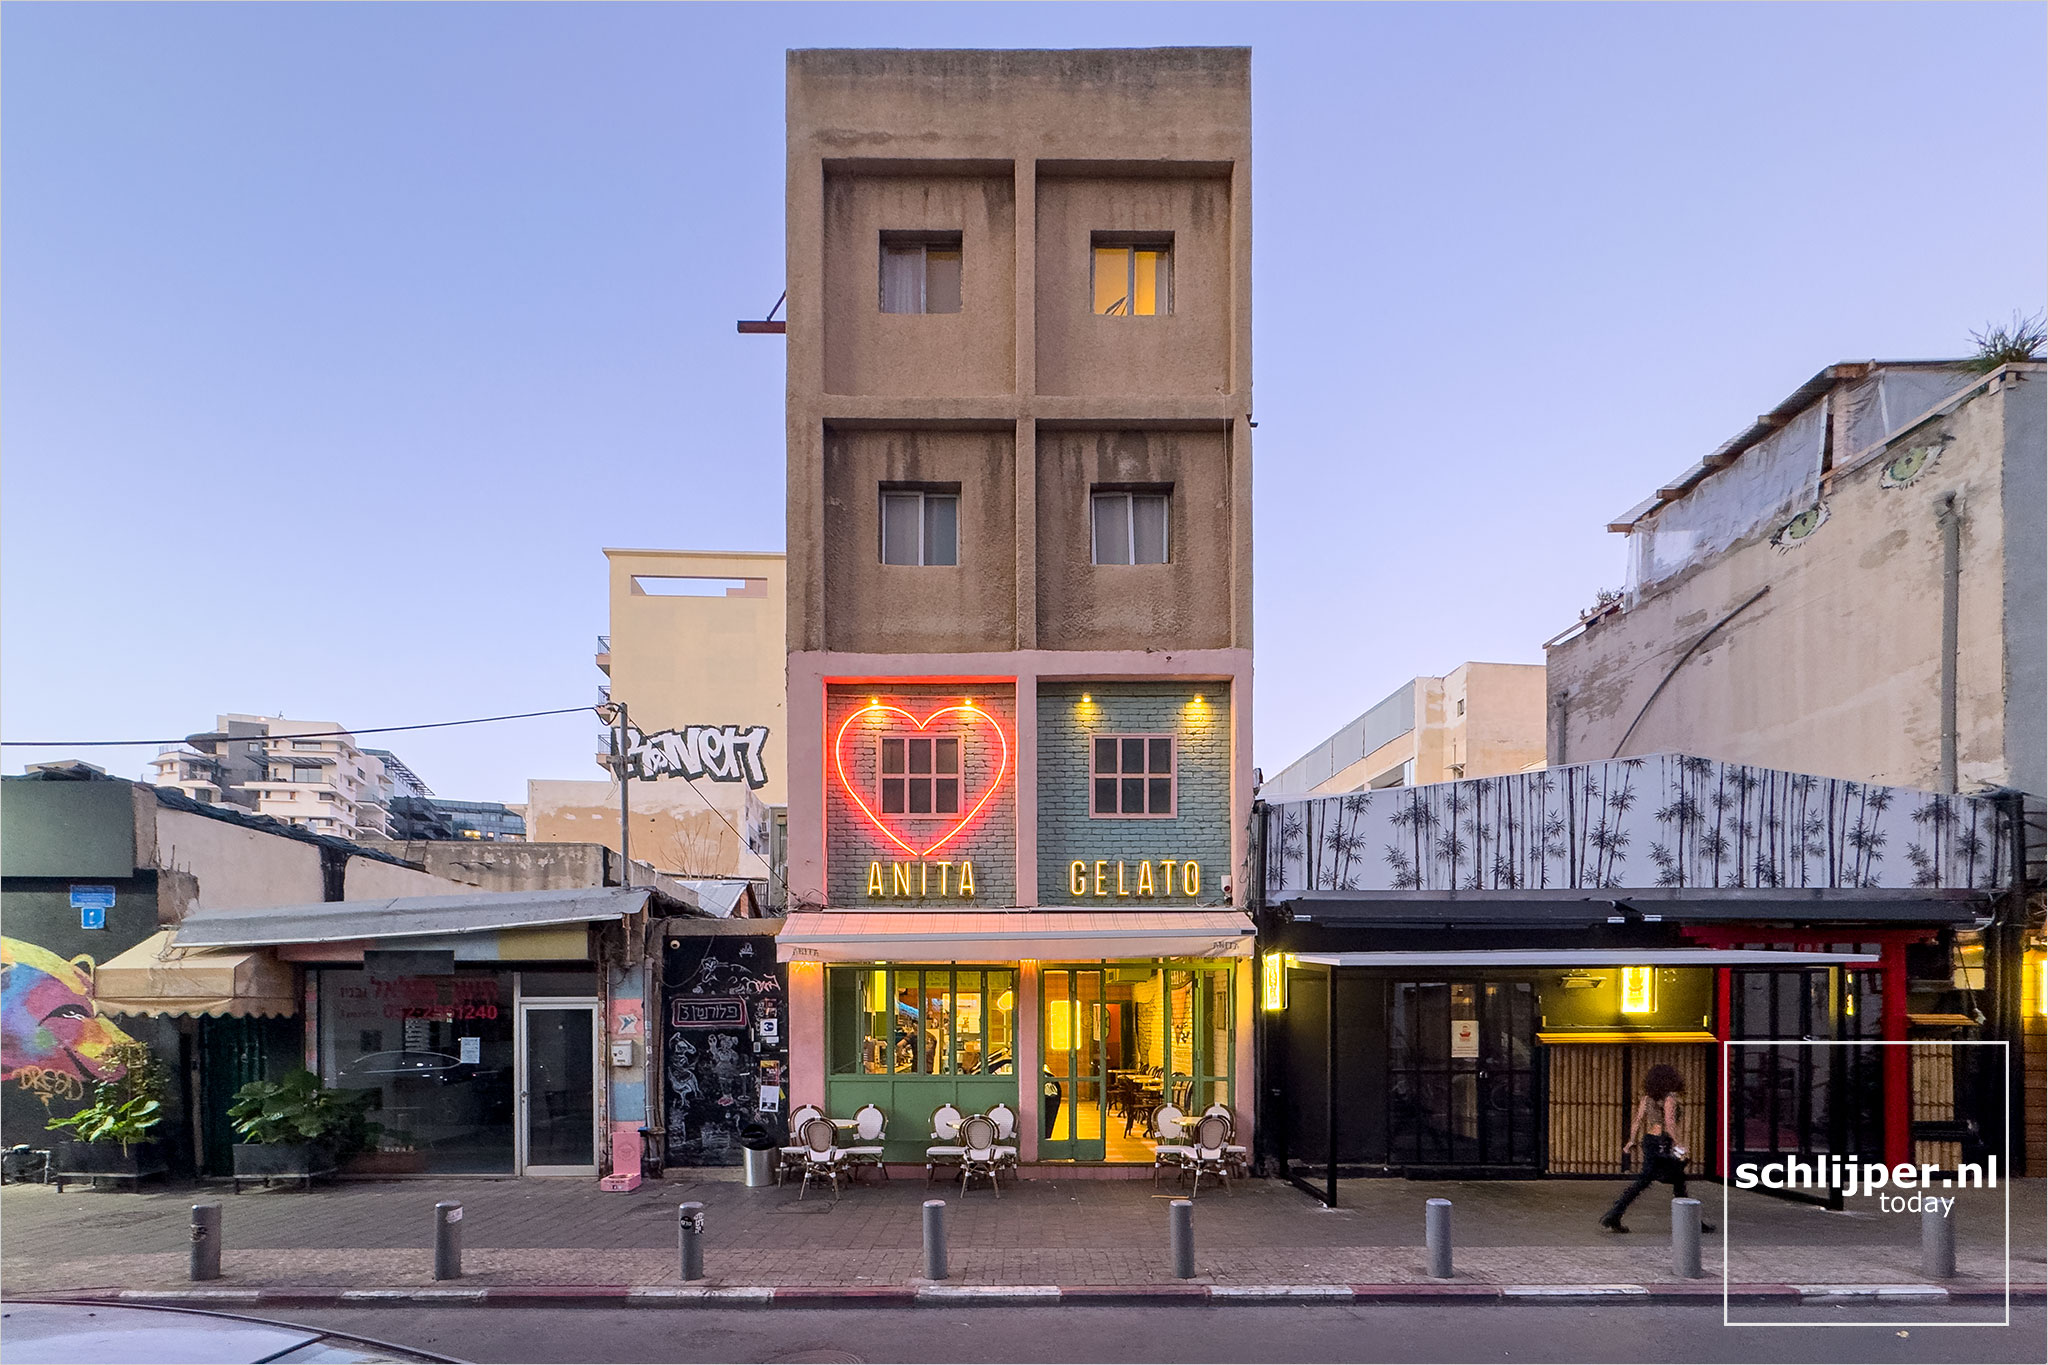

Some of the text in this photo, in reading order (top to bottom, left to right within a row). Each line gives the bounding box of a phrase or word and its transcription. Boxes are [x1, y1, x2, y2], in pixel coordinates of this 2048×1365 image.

[867, 860, 976, 896] ANITA
[1069, 860, 1200, 896] GELATO
[692, 1004, 738, 1021] פלורנטין
